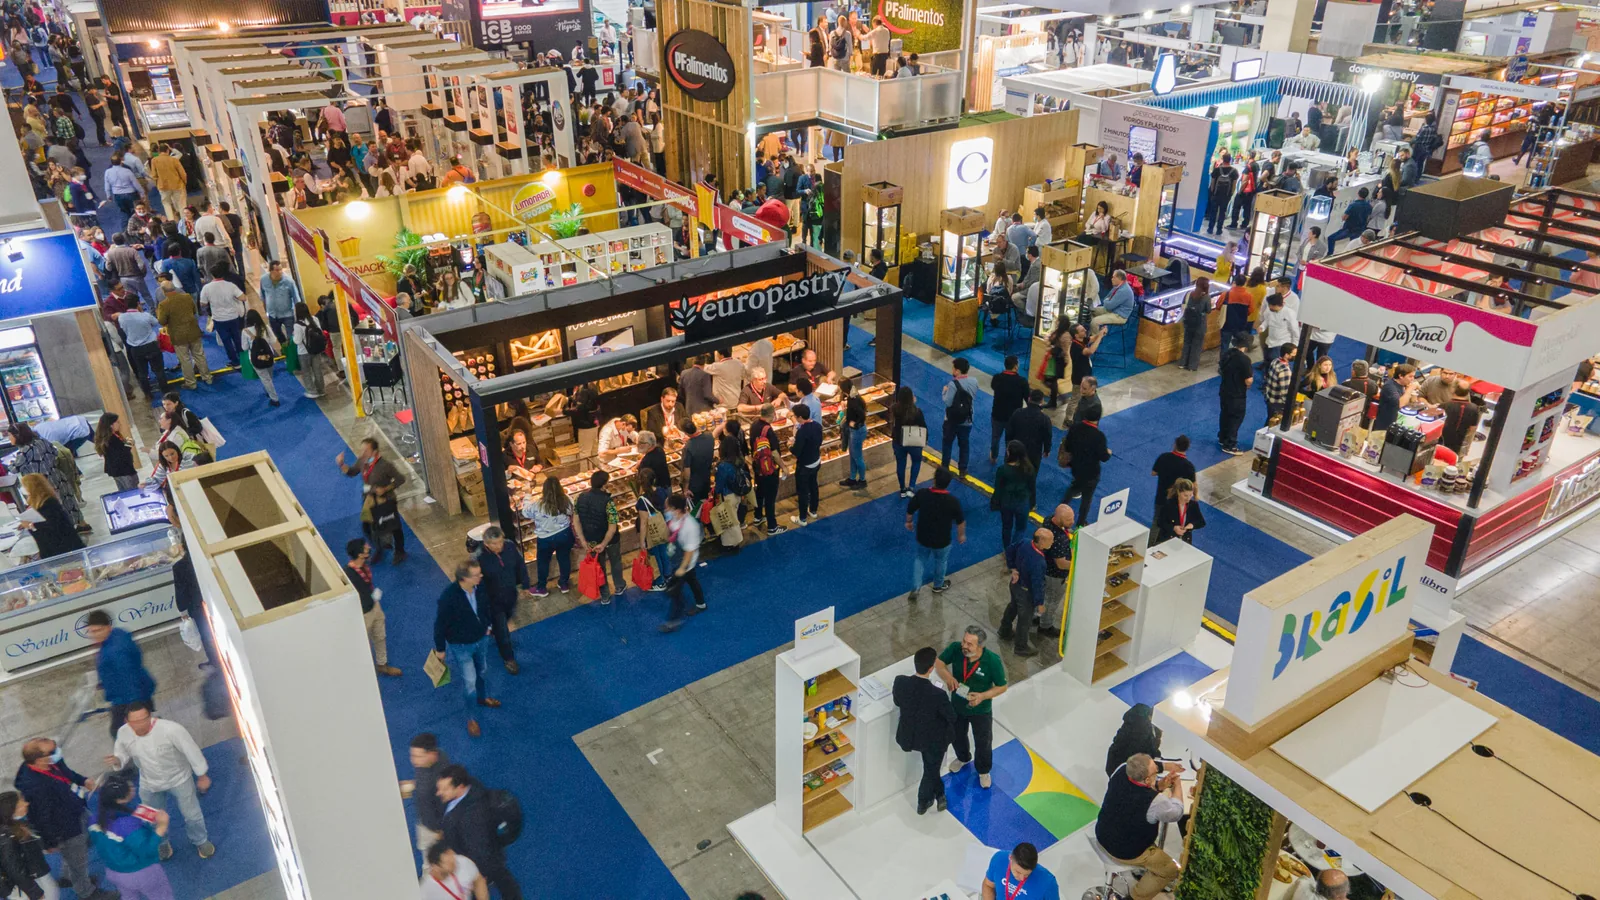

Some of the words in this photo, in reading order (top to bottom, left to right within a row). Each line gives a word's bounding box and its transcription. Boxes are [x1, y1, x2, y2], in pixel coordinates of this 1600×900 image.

[885, 1, 944, 27] PFalimentos
[674, 51, 728, 84] PFalimentos
[1123, 115, 1144, 125] VIDRIOS
[1108, 145, 1128, 154] MINUTO
[1162, 146, 1187, 157] REDUCIR
[1162, 156, 1188, 167] RECICLAR
[956, 151, 989, 184] C
[515, 190, 551, 211] LIMONADA
[0, 267, 23, 294] nd
[701, 269, 850, 322] europastry
[1379, 323, 1448, 347] DaVinci
[1412, 342, 1438, 354] GOURMET
[5, 629, 69, 658] South
[118, 595, 174, 623] Wind
